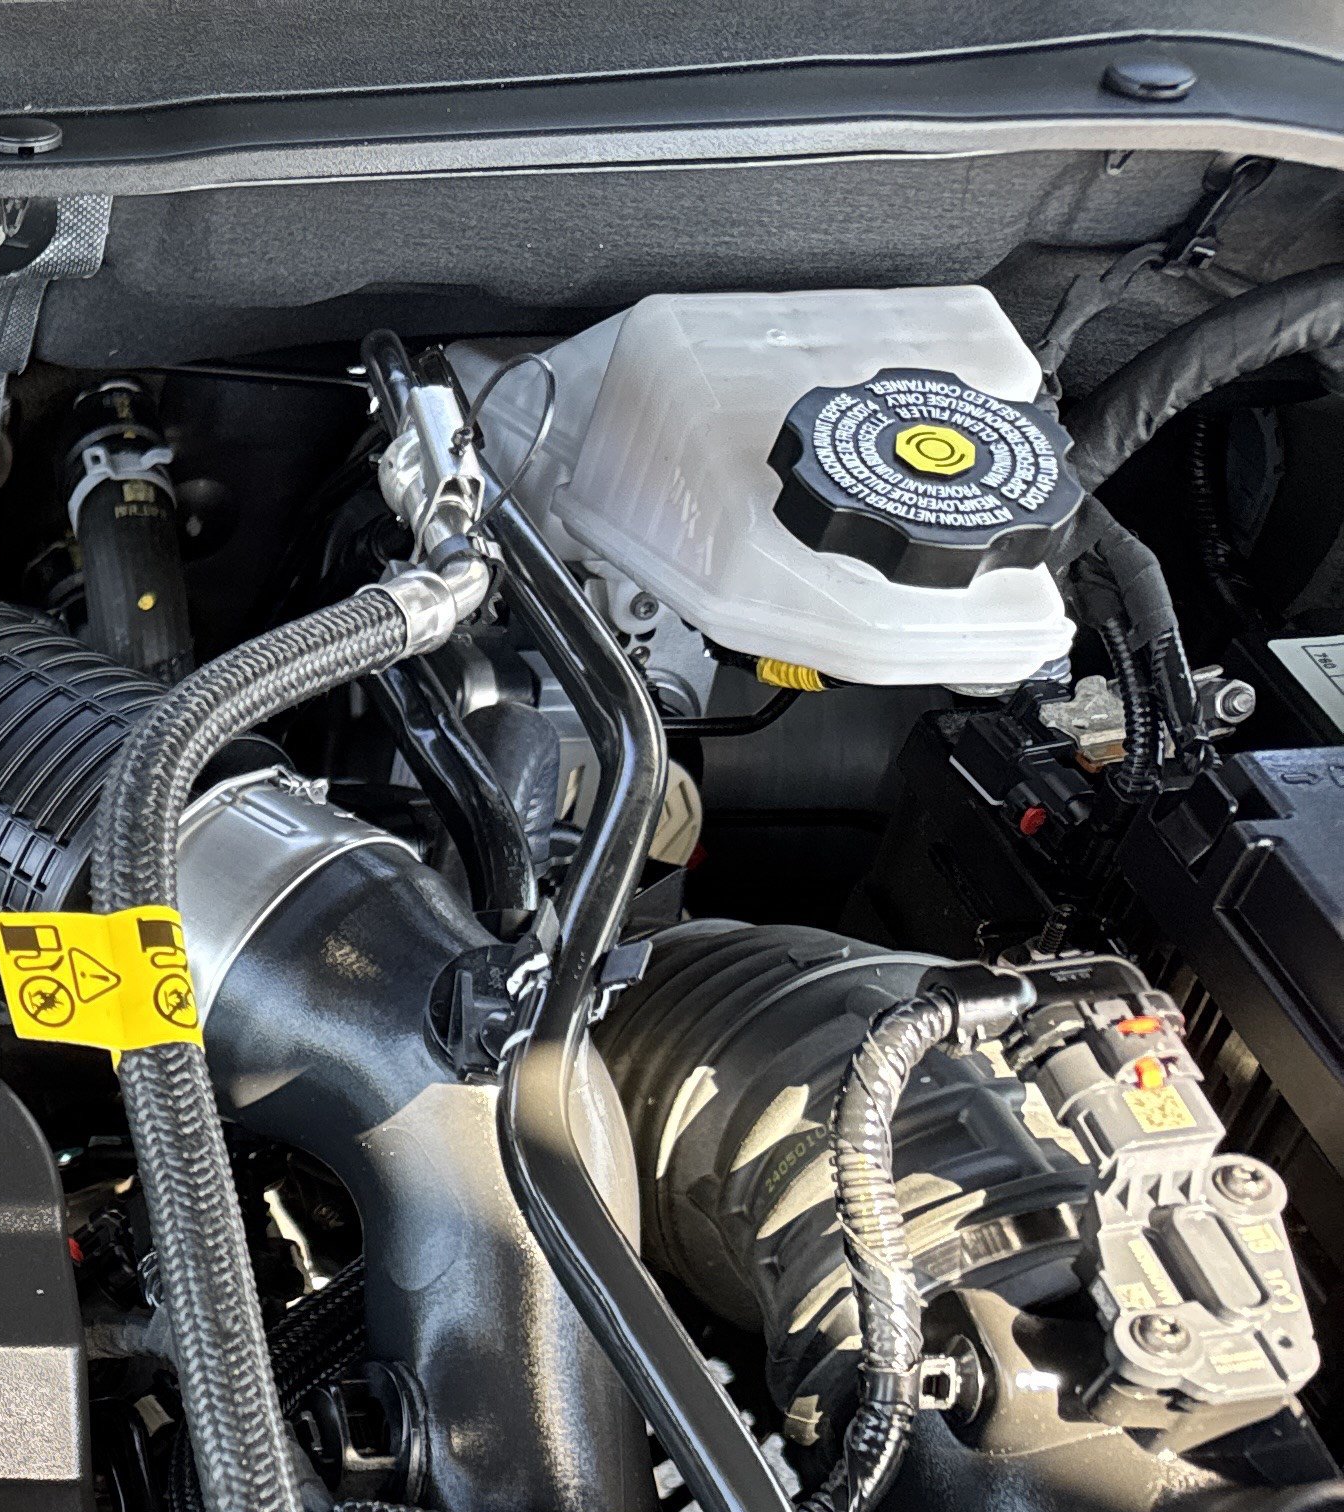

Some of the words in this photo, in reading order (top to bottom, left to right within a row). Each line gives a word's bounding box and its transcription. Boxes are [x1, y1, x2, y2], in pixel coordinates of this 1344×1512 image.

[885, 392, 924, 406] ONLY
[962, 390, 1021, 420] SEALED
[846, 403, 872, 421] DOT
[895, 405, 950, 420] FILLER
[813, 419, 833, 447] AVANT
[951, 413, 998, 441] CLEAN
[835, 440, 855, 452] DE
[1021, 425, 1054, 455] FROM
[816, 447, 856, 487] BOUCHON
[839, 452, 877, 484] LIQUIDE
[1011, 442, 1035, 481] BEFORE
[847, 483, 871, 498] LE
[868, 479, 892, 494] DU
[887, 487, 917, 504] QUE
[898, 478, 981, 497] PROVENANT
[1000, 477, 1027, 499] CAP
[1018, 486, 1048, 510] DOT
[865, 492, 936, 523] NETTOYER
